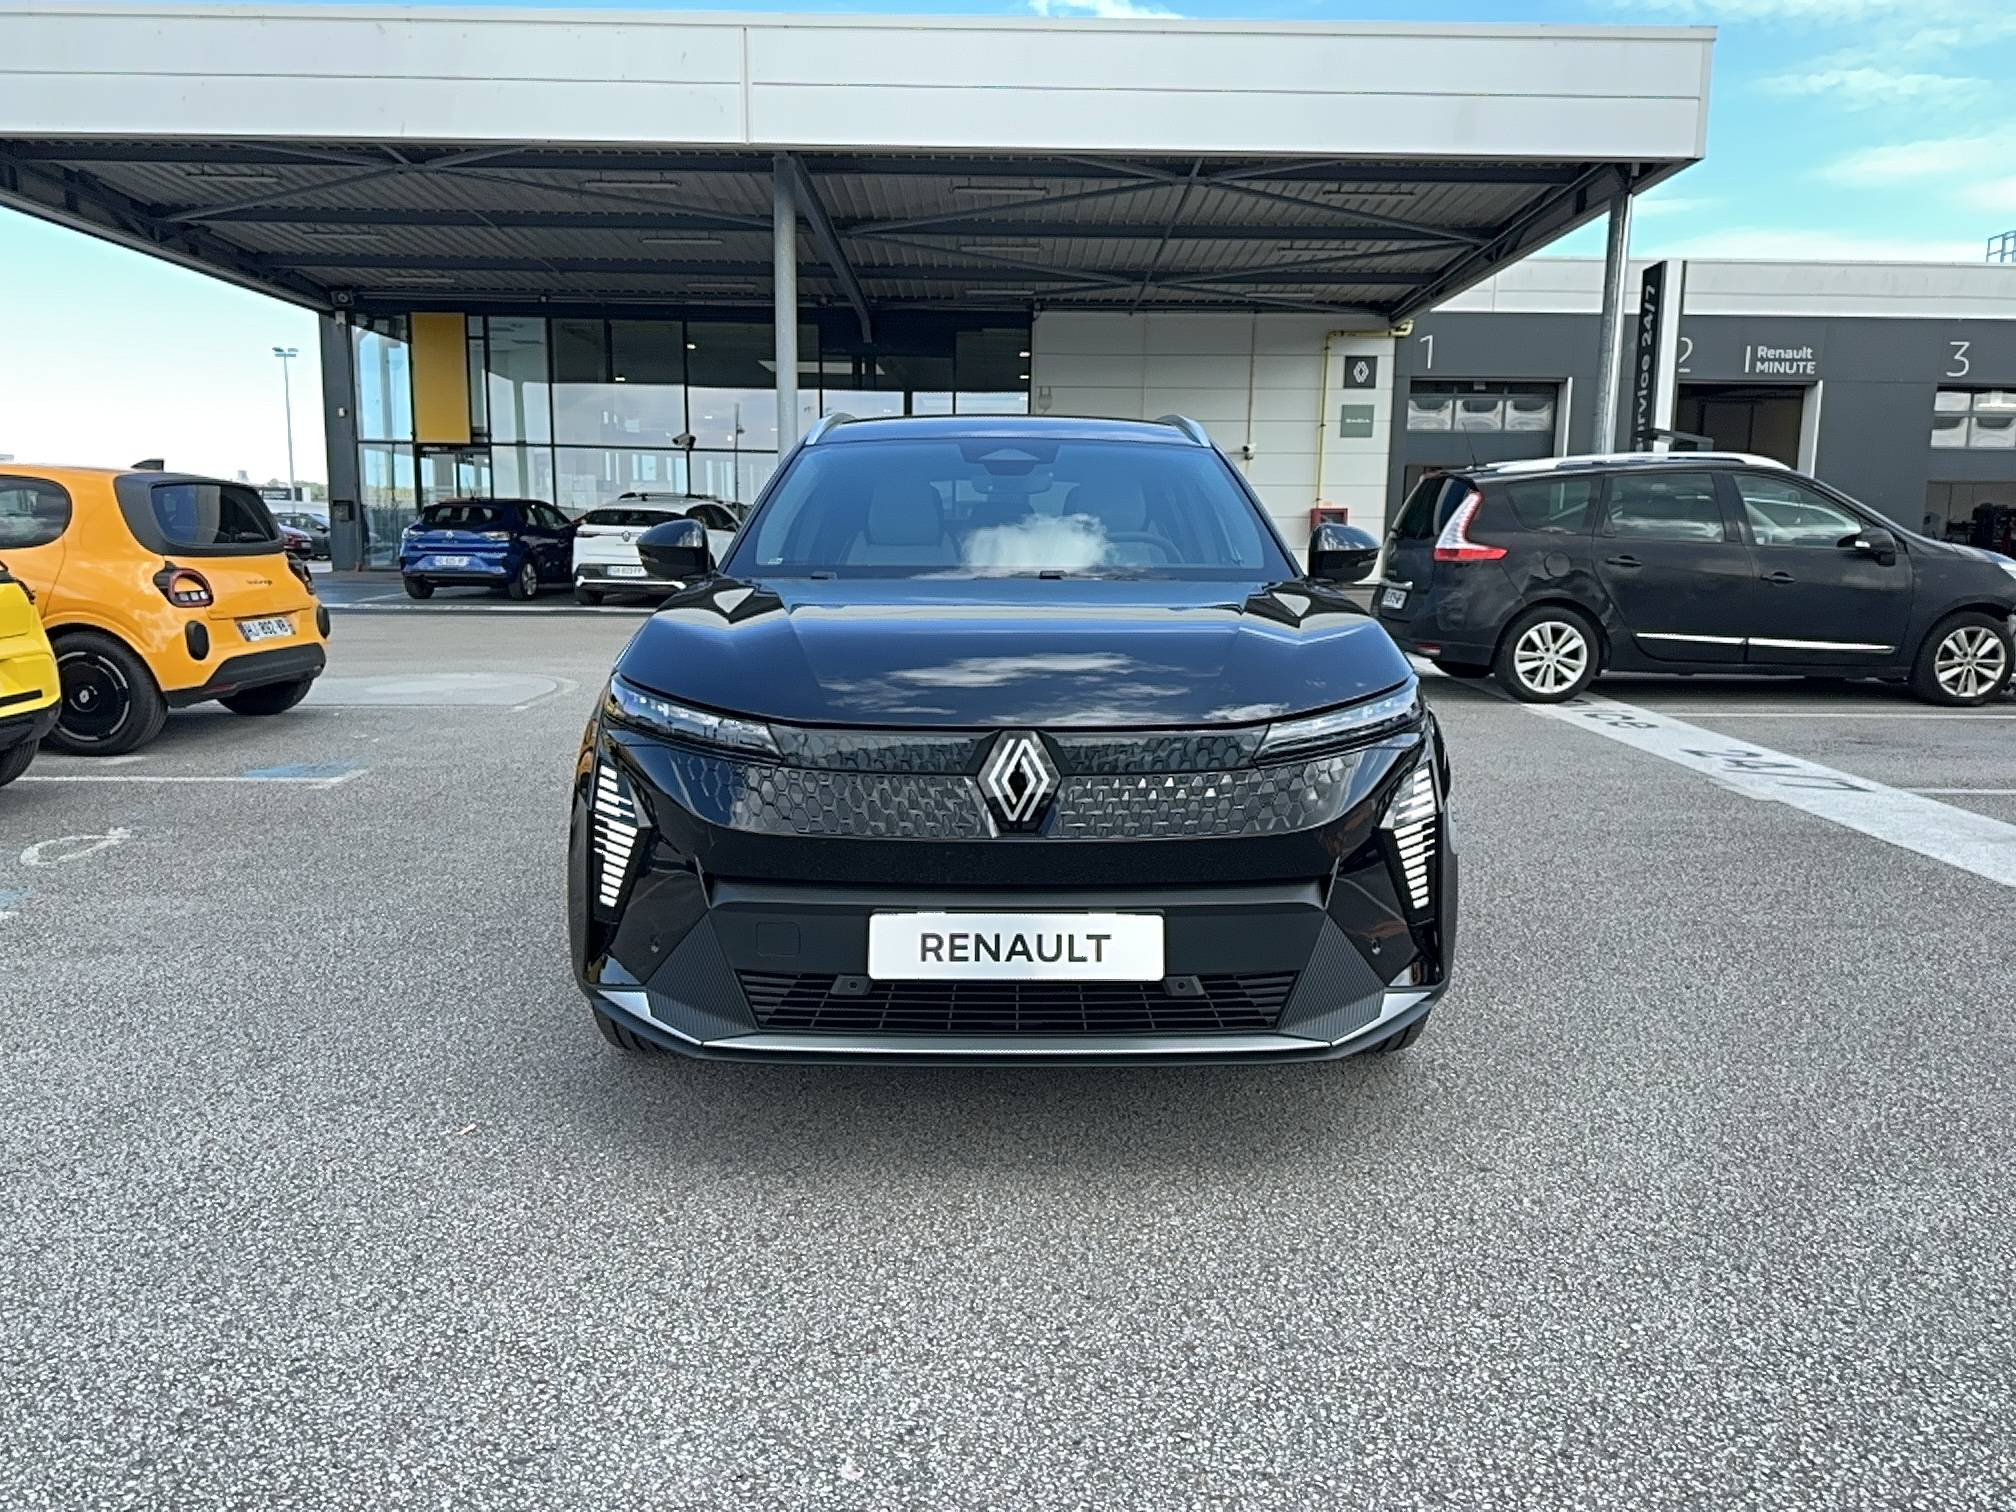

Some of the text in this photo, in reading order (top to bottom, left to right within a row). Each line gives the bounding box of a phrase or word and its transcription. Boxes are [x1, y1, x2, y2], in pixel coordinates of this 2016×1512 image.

[1641, 284, 1656, 348] 24/7
[1419, 334, 1433, 369] 1
[1678, 337, 1693, 373] 2
[1755, 361, 1816, 374] MINUTE
[1757, 345, 1813, 359] Renault
[1946, 341, 1970, 377] 3
[920, 932, 1112, 963] RENAULT
